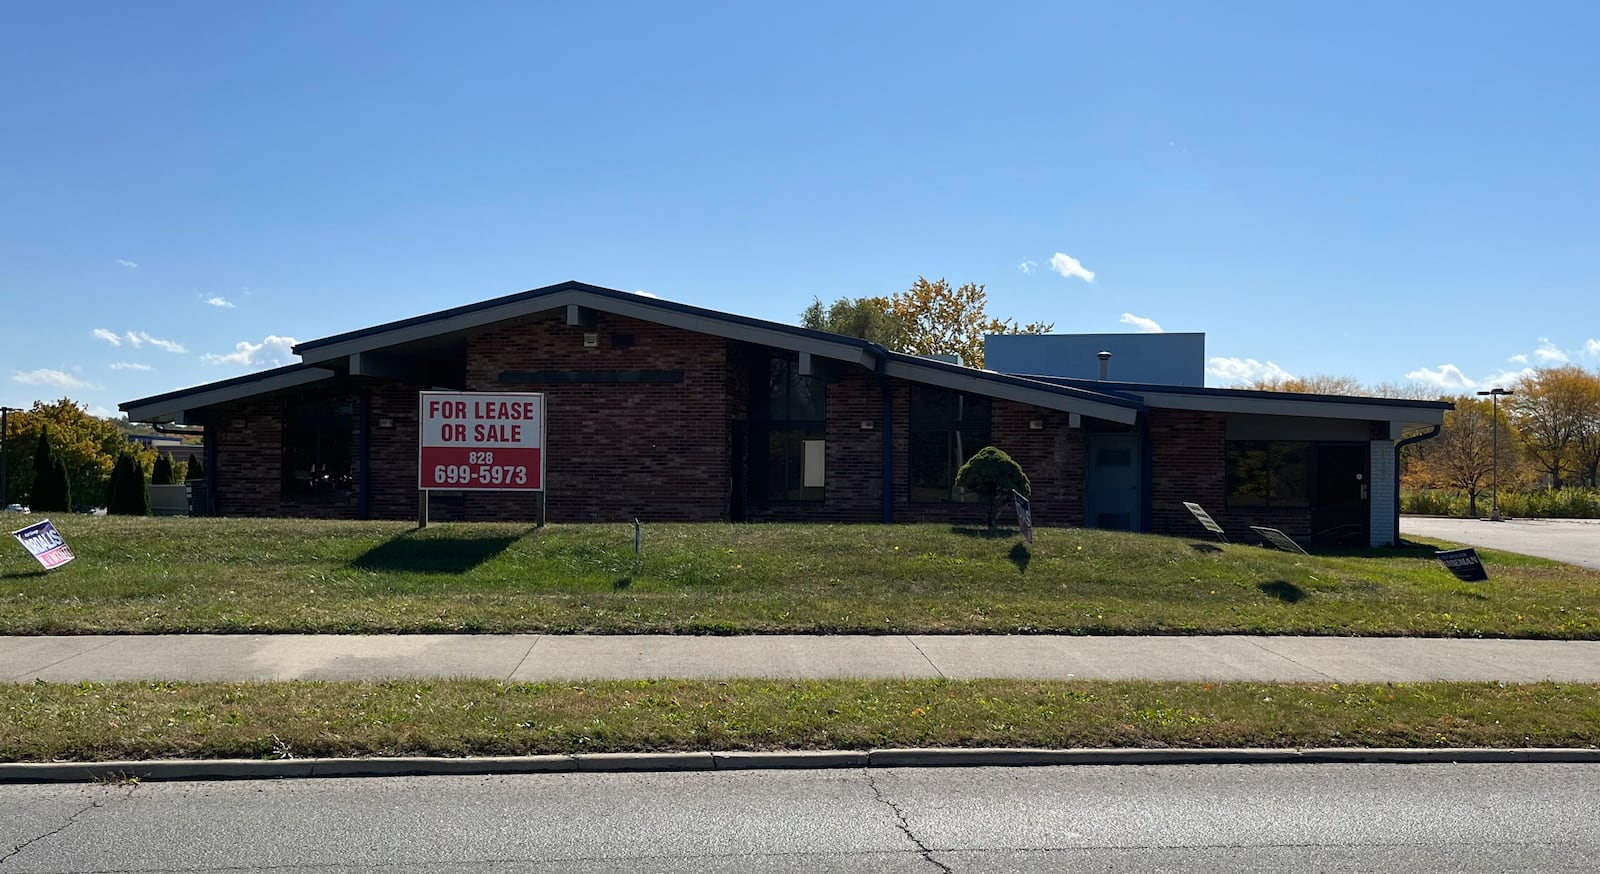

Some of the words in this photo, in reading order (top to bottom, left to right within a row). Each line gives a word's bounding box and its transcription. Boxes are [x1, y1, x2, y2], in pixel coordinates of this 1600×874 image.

[429, 401, 467, 419] FOR
[474, 401, 534, 420] LEASE
[441, 424, 467, 442] OR
[474, 424, 522, 442] SALE
[469, 451, 494, 464] 828
[434, 465, 527, 484] 699-5973
